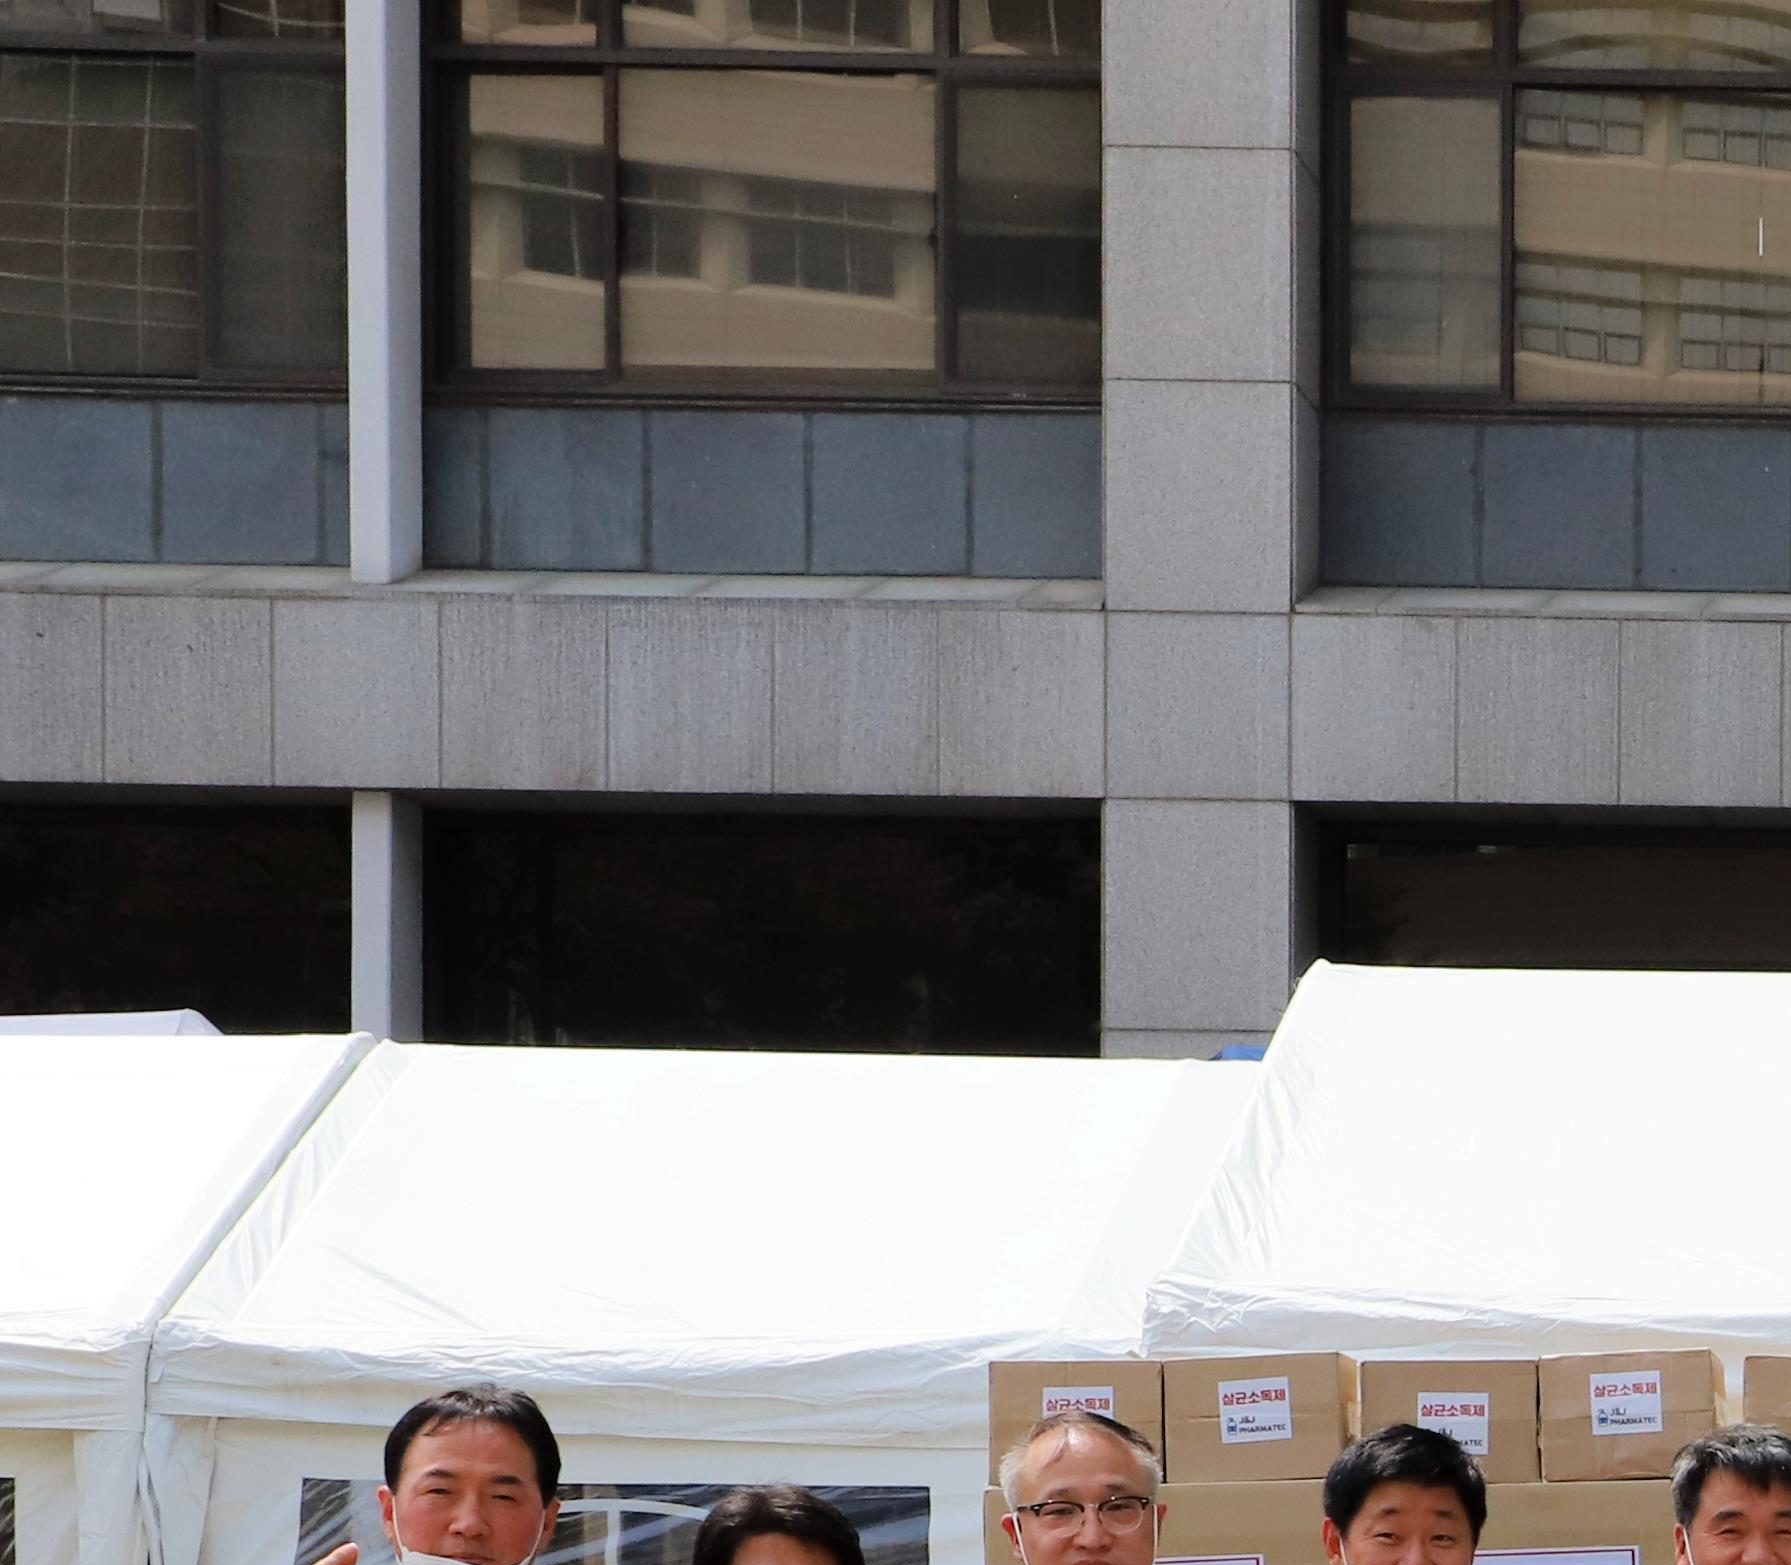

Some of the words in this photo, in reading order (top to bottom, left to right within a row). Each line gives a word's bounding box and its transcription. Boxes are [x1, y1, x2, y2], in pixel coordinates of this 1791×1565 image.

[1594, 1382, 1657, 1397] 살균소독제
[1222, 1389, 1286, 1406] 살균소독제
[1421, 1404, 1485, 1417] 살균소독제
[1610, 1416, 1657, 1425] PHARMATEC
[1239, 1424, 1286, 1434] PHARMATEC
